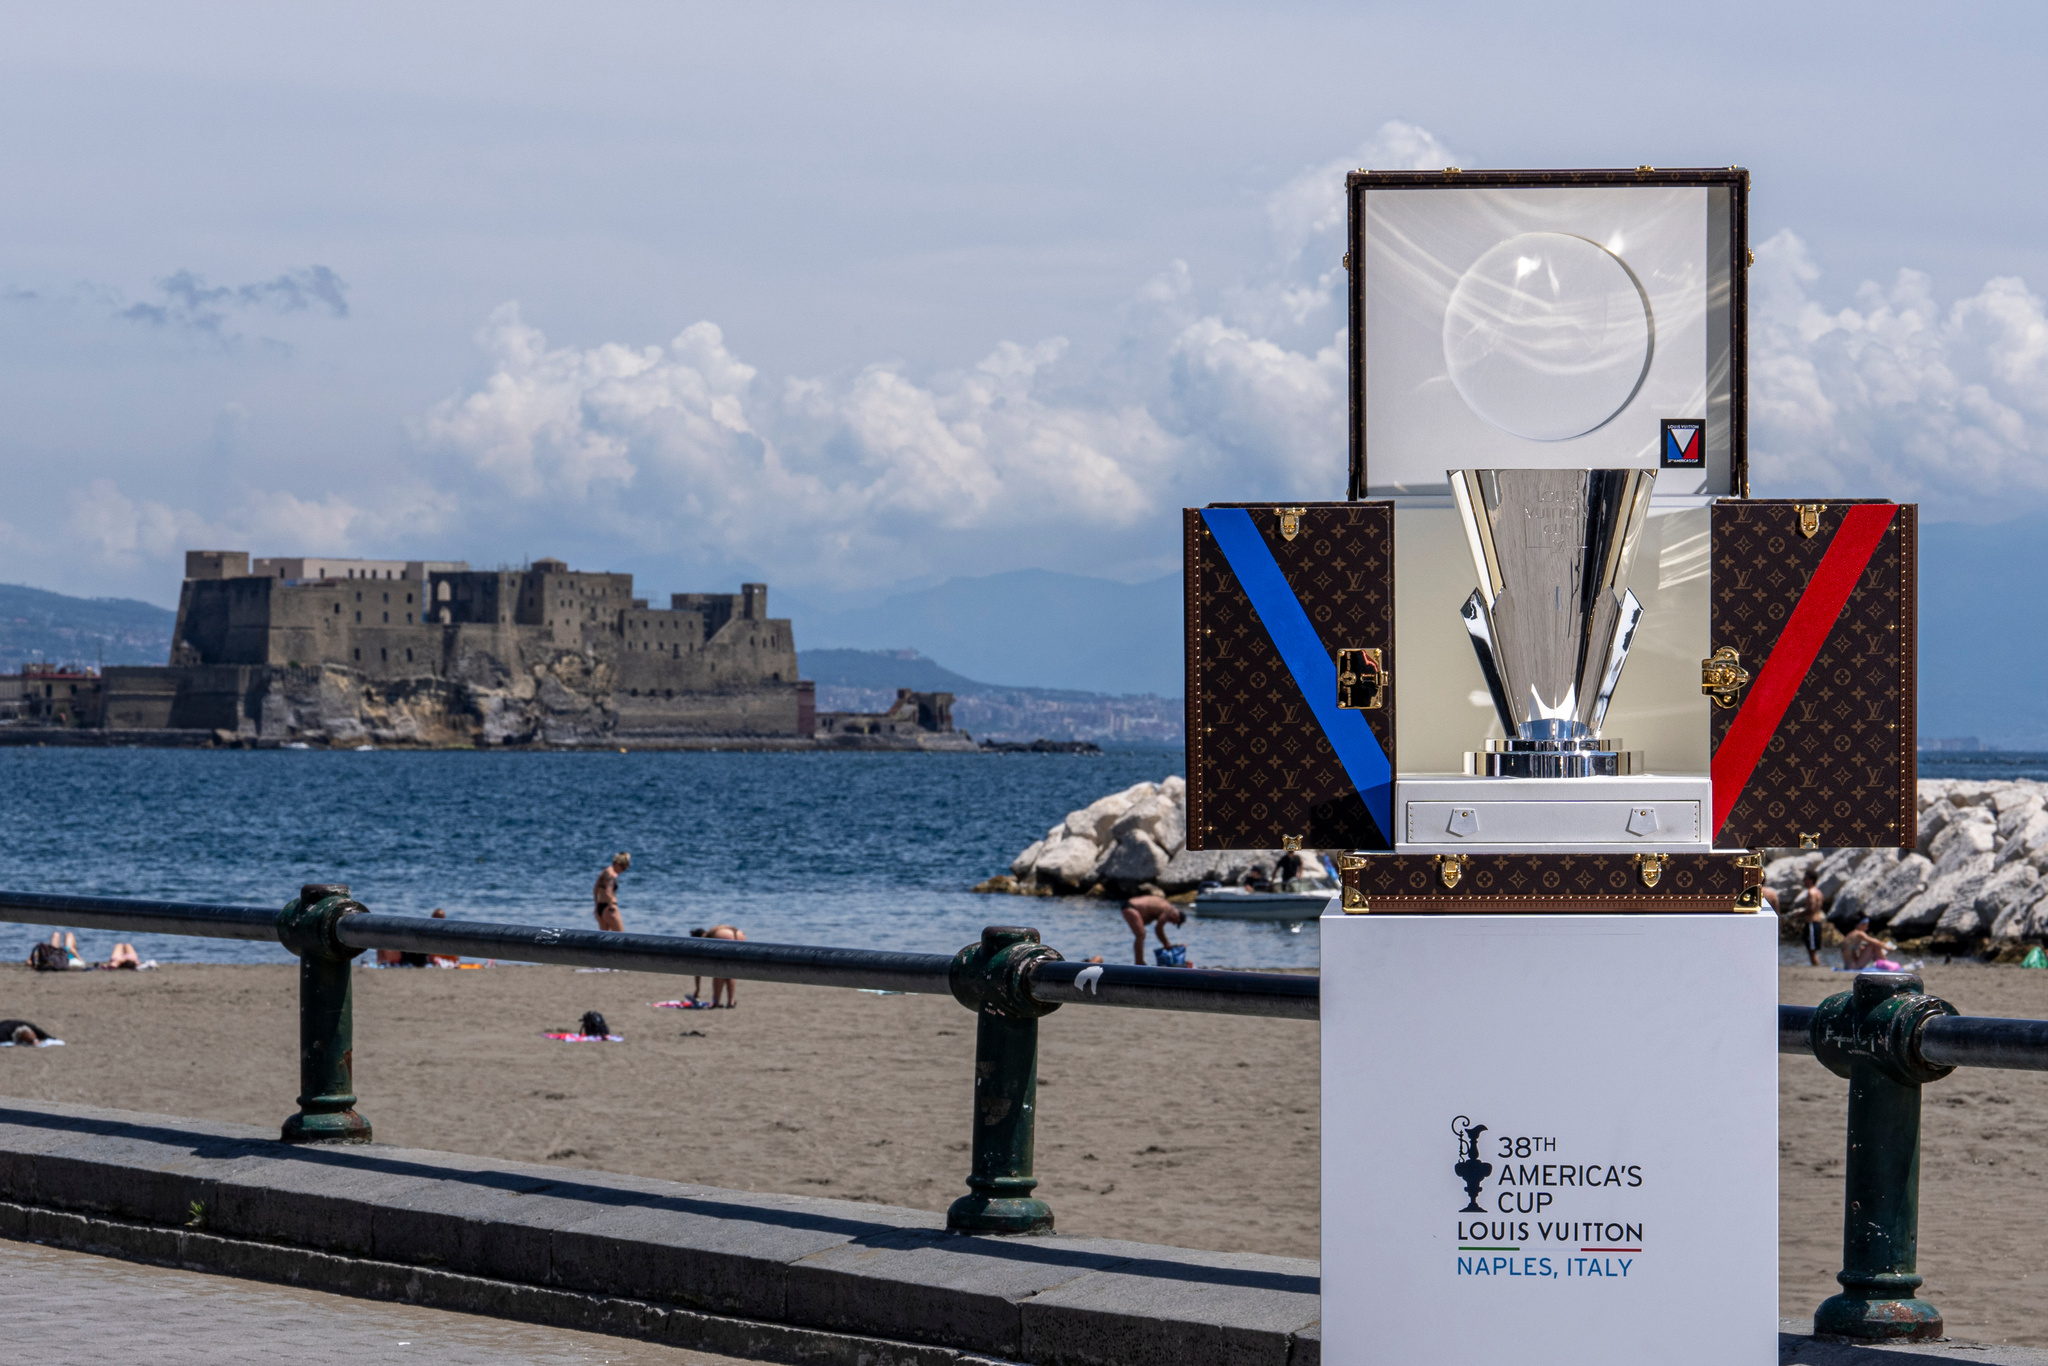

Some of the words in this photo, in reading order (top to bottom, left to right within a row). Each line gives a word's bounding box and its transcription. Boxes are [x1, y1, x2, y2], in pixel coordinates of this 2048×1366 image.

[1497, 1136, 1556, 1158] 38TH
[1497, 1164, 1643, 1187] AMERICA'S
[1497, 1191, 1553, 1213] CUP
[1457, 1221, 1530, 1241] LOUIS
[1537, 1222, 1643, 1242] VUITTON
[1457, 1256, 1558, 1279] NAPLES,
[1567, 1258, 1633, 1277] ITALY
